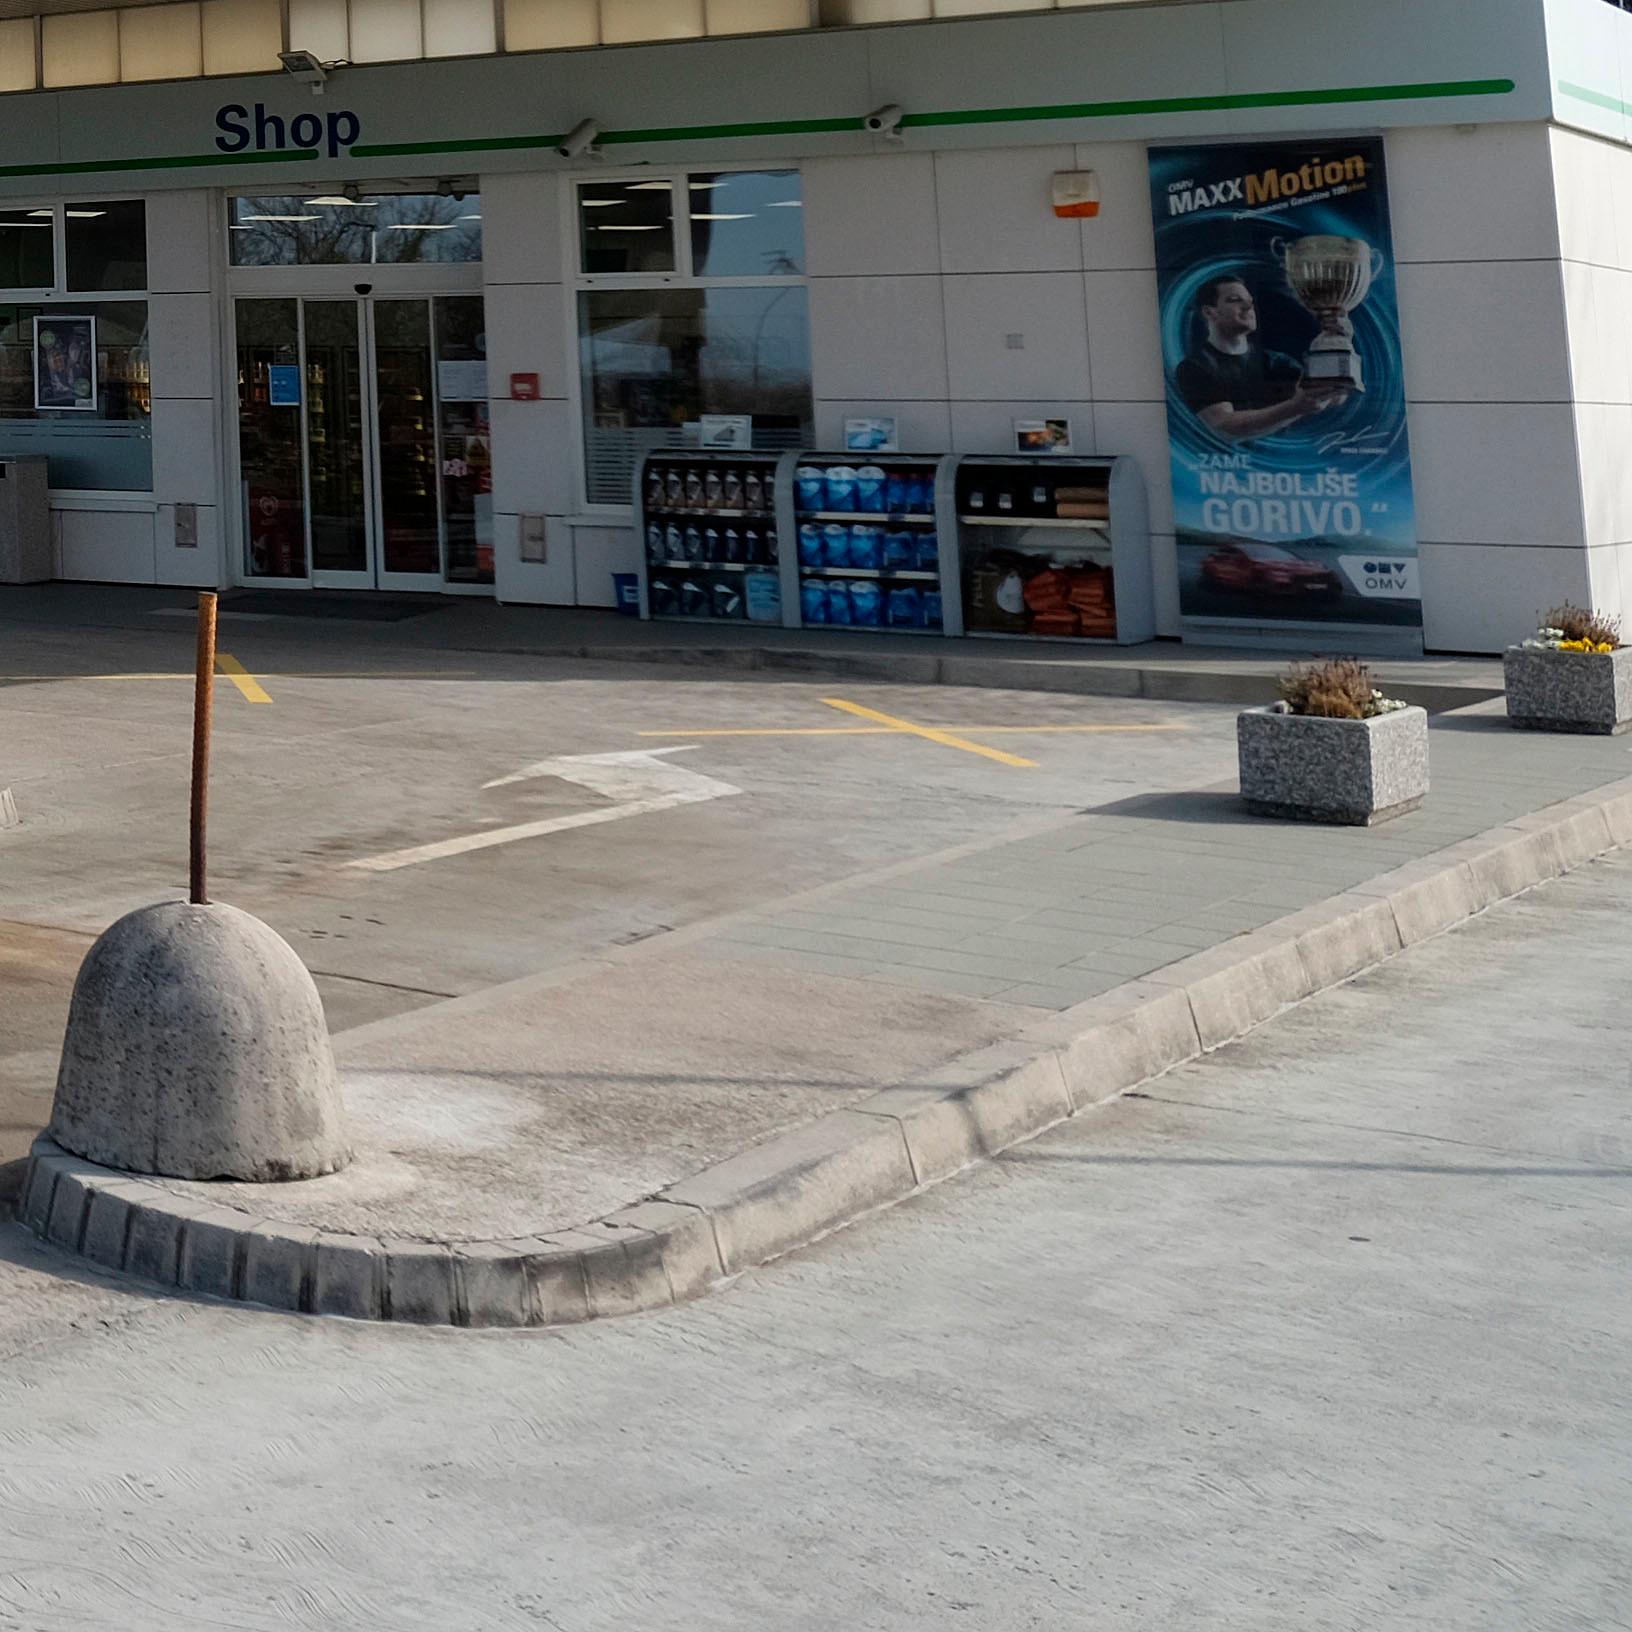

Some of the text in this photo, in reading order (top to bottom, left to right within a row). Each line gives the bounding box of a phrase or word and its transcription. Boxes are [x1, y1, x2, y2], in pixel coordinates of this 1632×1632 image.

[214, 103, 361, 158] Shop
[1199, 467, 1359, 498] NAJBOLJŠE
[1364, 577, 1407, 590] OMV
